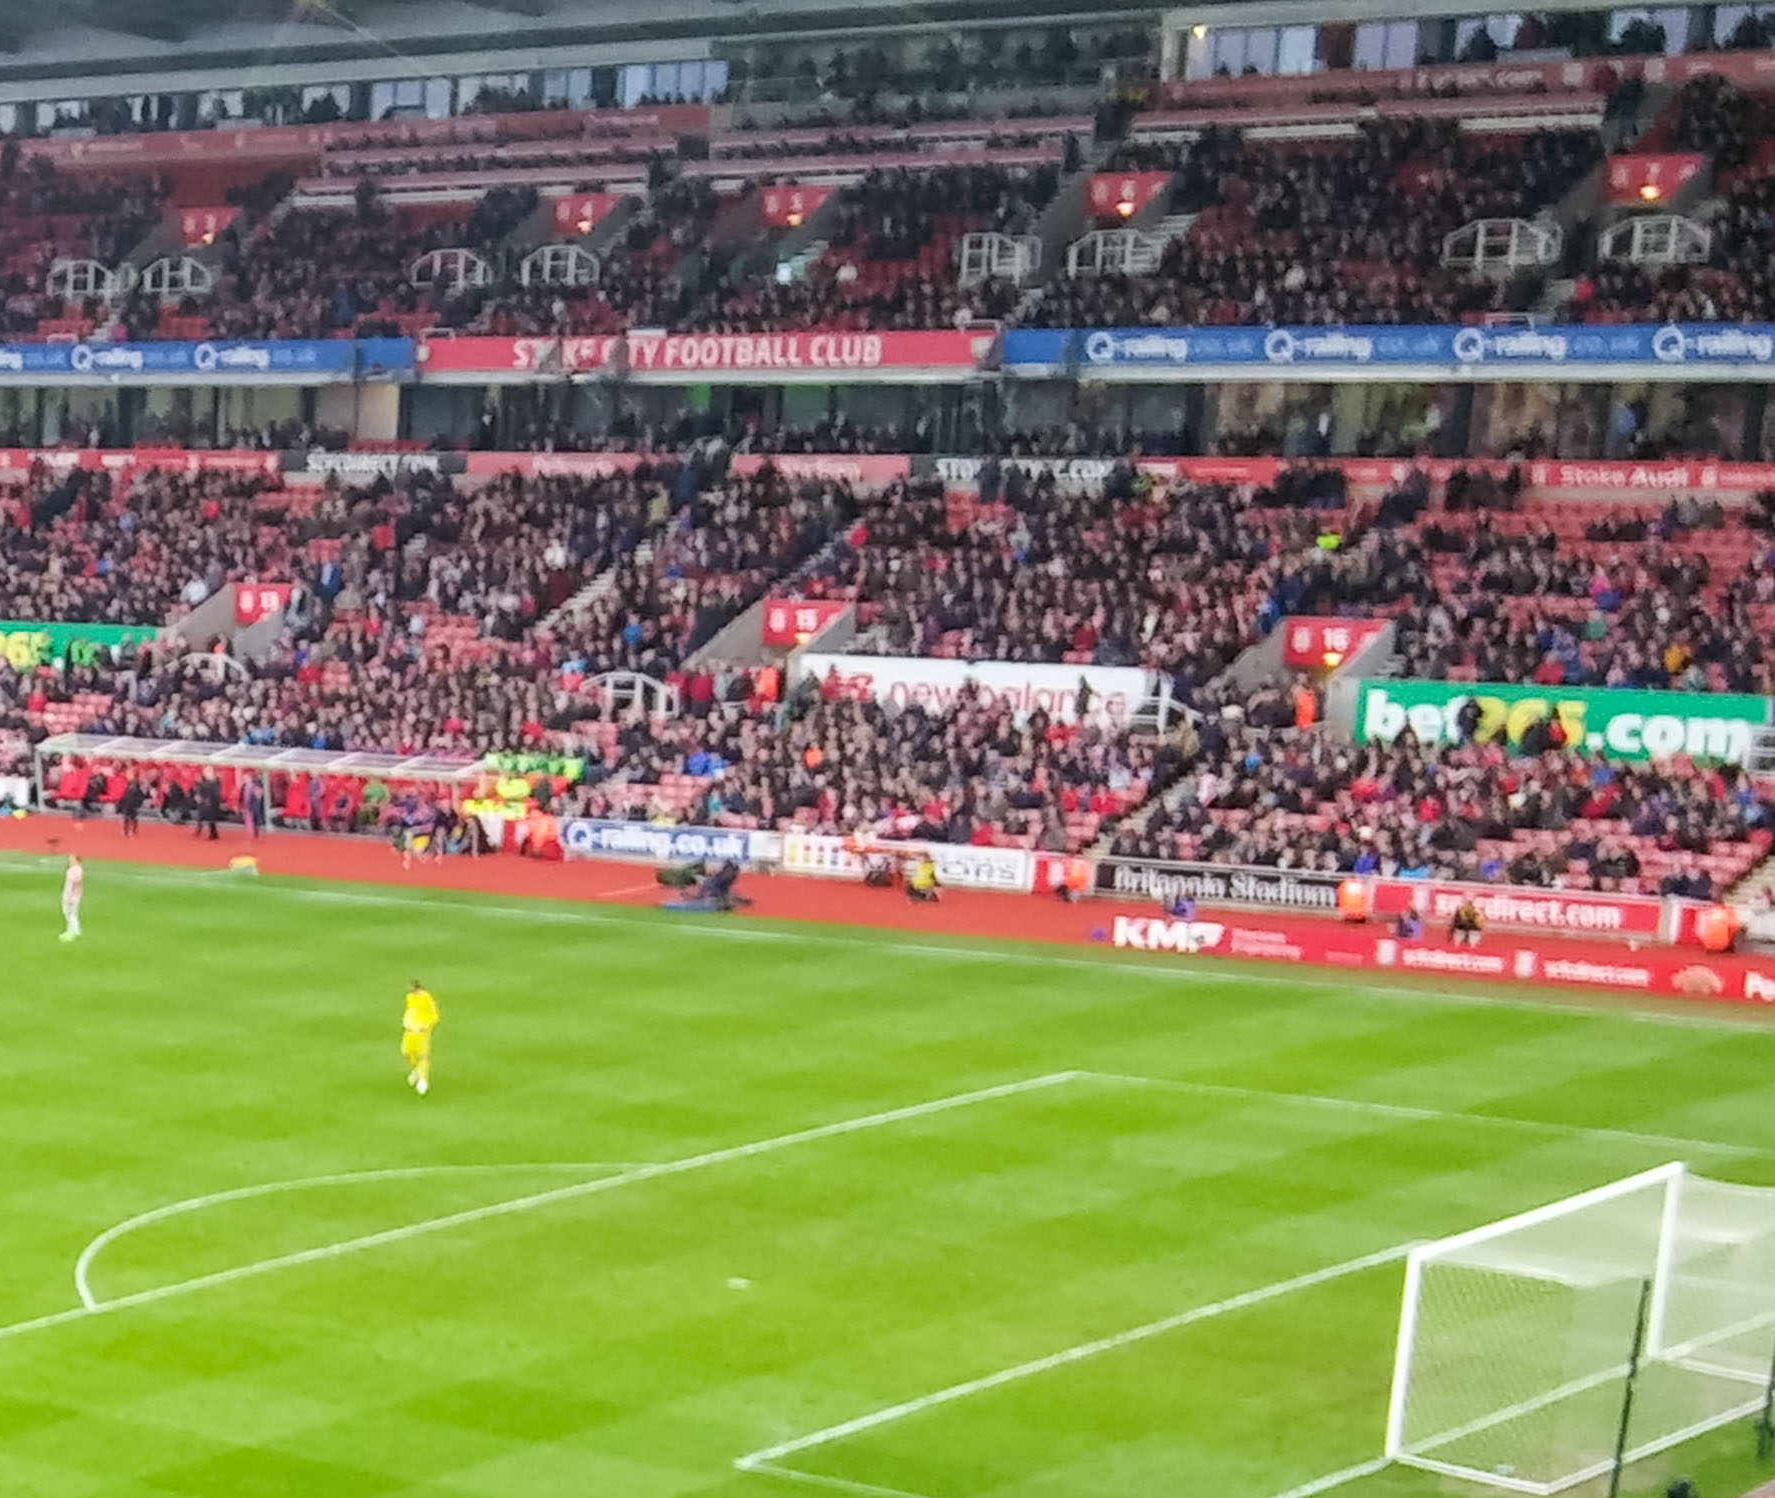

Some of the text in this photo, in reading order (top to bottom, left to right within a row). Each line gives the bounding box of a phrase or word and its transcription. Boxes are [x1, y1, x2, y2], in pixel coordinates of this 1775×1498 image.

[513, 336, 598, 368] STKE
[664, 334, 801, 366] FOOTBALL
[809, 334, 882, 366] CLUB
[1114, 865, 1338, 907] Britannia Stadium
